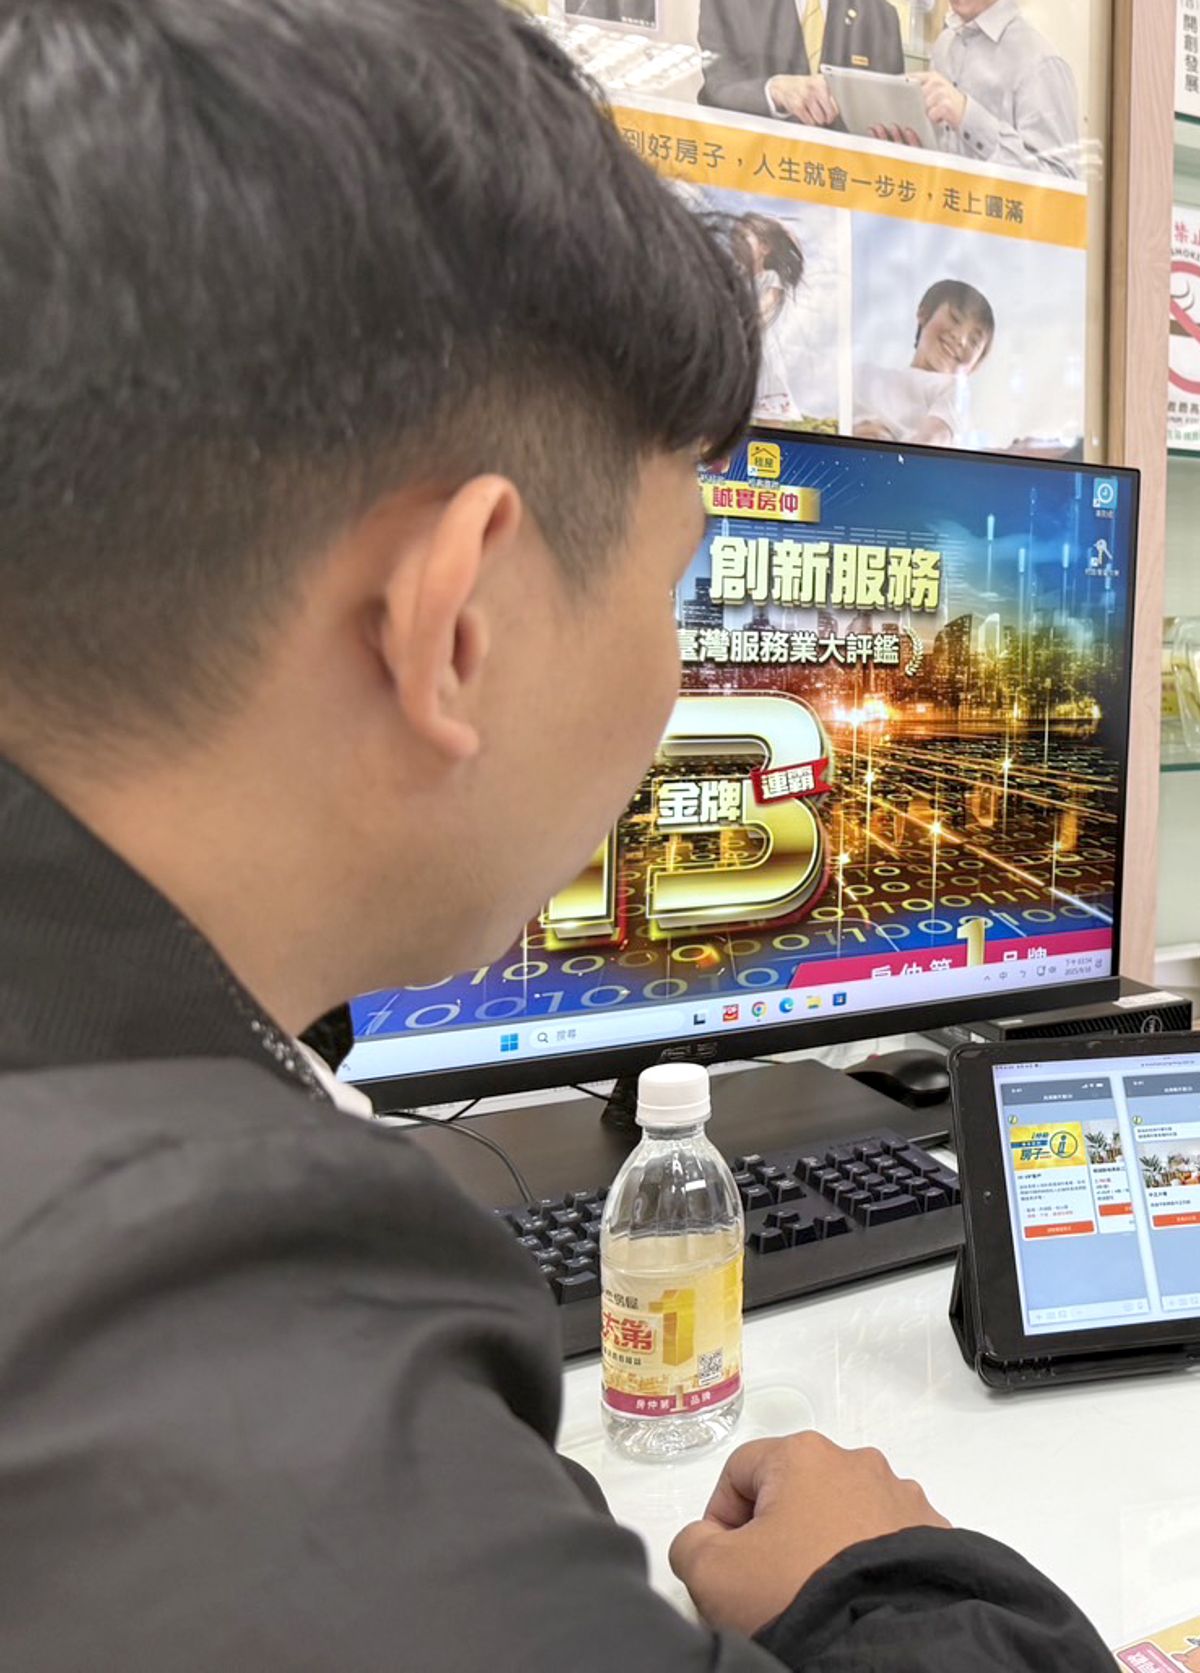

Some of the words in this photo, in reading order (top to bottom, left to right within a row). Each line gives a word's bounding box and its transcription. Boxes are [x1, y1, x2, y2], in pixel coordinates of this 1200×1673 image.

[712, 486, 799, 513] 誠實房仲
[709, 535, 943, 612] 創新服務
[677, 627, 900, 664] 臺灣服務業大評鑑
[761, 764, 815, 800] 連霸
[657, 780, 741, 824] 金牌
